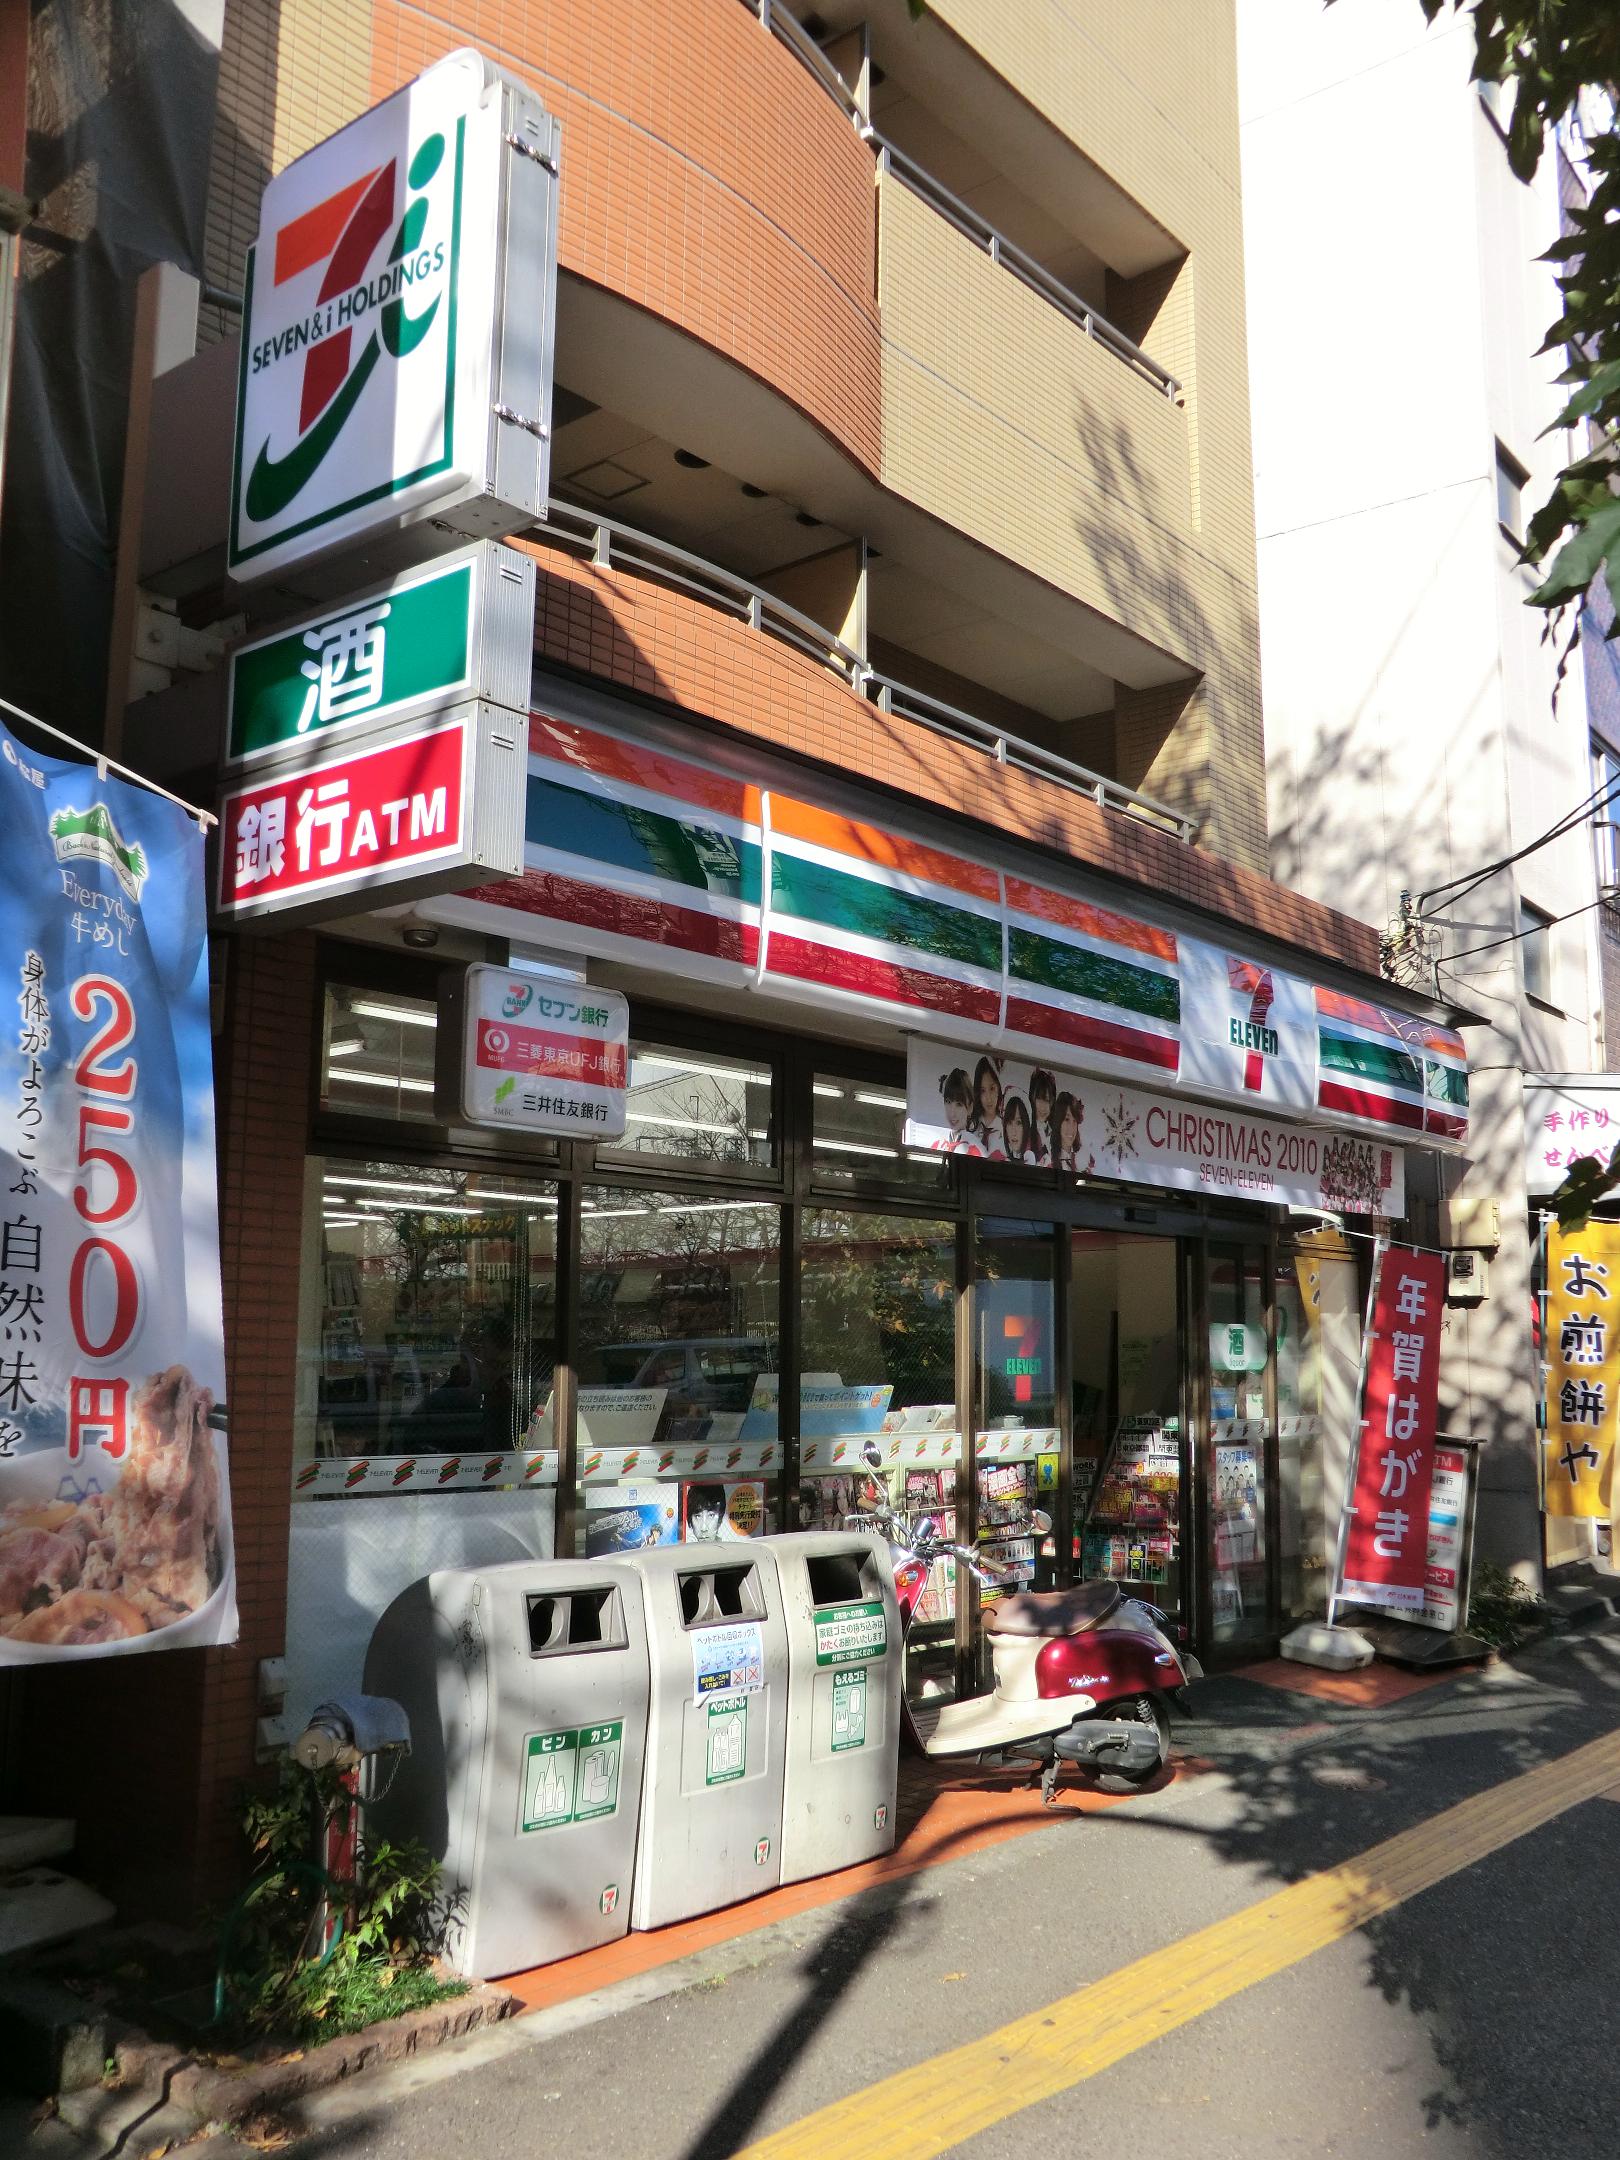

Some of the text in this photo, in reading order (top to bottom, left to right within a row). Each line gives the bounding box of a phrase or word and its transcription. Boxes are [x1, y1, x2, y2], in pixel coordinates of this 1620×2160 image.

[337, 241, 445, 328] HOLDINGS
[297, 602, 392, 734] 酒
[58, 868, 138, 936] Everyday
[70, 911, 129, 957] 牛めし
[538, 995, 609, 1028] セブン銀行
[516, 1041, 622, 1074] 三菱東京UFJ銀行
[522, 1093, 609, 1122] 三井住友銀行
[1544, 1107, 1610, 1133] 手作り
[1144, 1106, 1319, 1176] CHRISTMAS 2010
[1199, 1162, 1275, 1193] SEVEN-ELEVEN
[68, 975, 140, 1460] 250円
[1229, 1328, 1245, 1355] 酒
[1560, 1253, 1611, 1484] お煎餅や
[1373, 1273, 1427, 1558] 年賀はがき
[1217, 1450, 1255, 1464] スタッフ募集中
[819, 1620, 884, 1638] 家庭ゴミの持ち込みは
[820, 1632, 883, 1651] かたくお断りいたします
[835, 1671, 865, 1686] もえるゴミ
[711, 1696, 746, 1712] ペットボトル
[542, 1736, 566, 1751] ビン
[591, 1728, 612, 1743] カン
